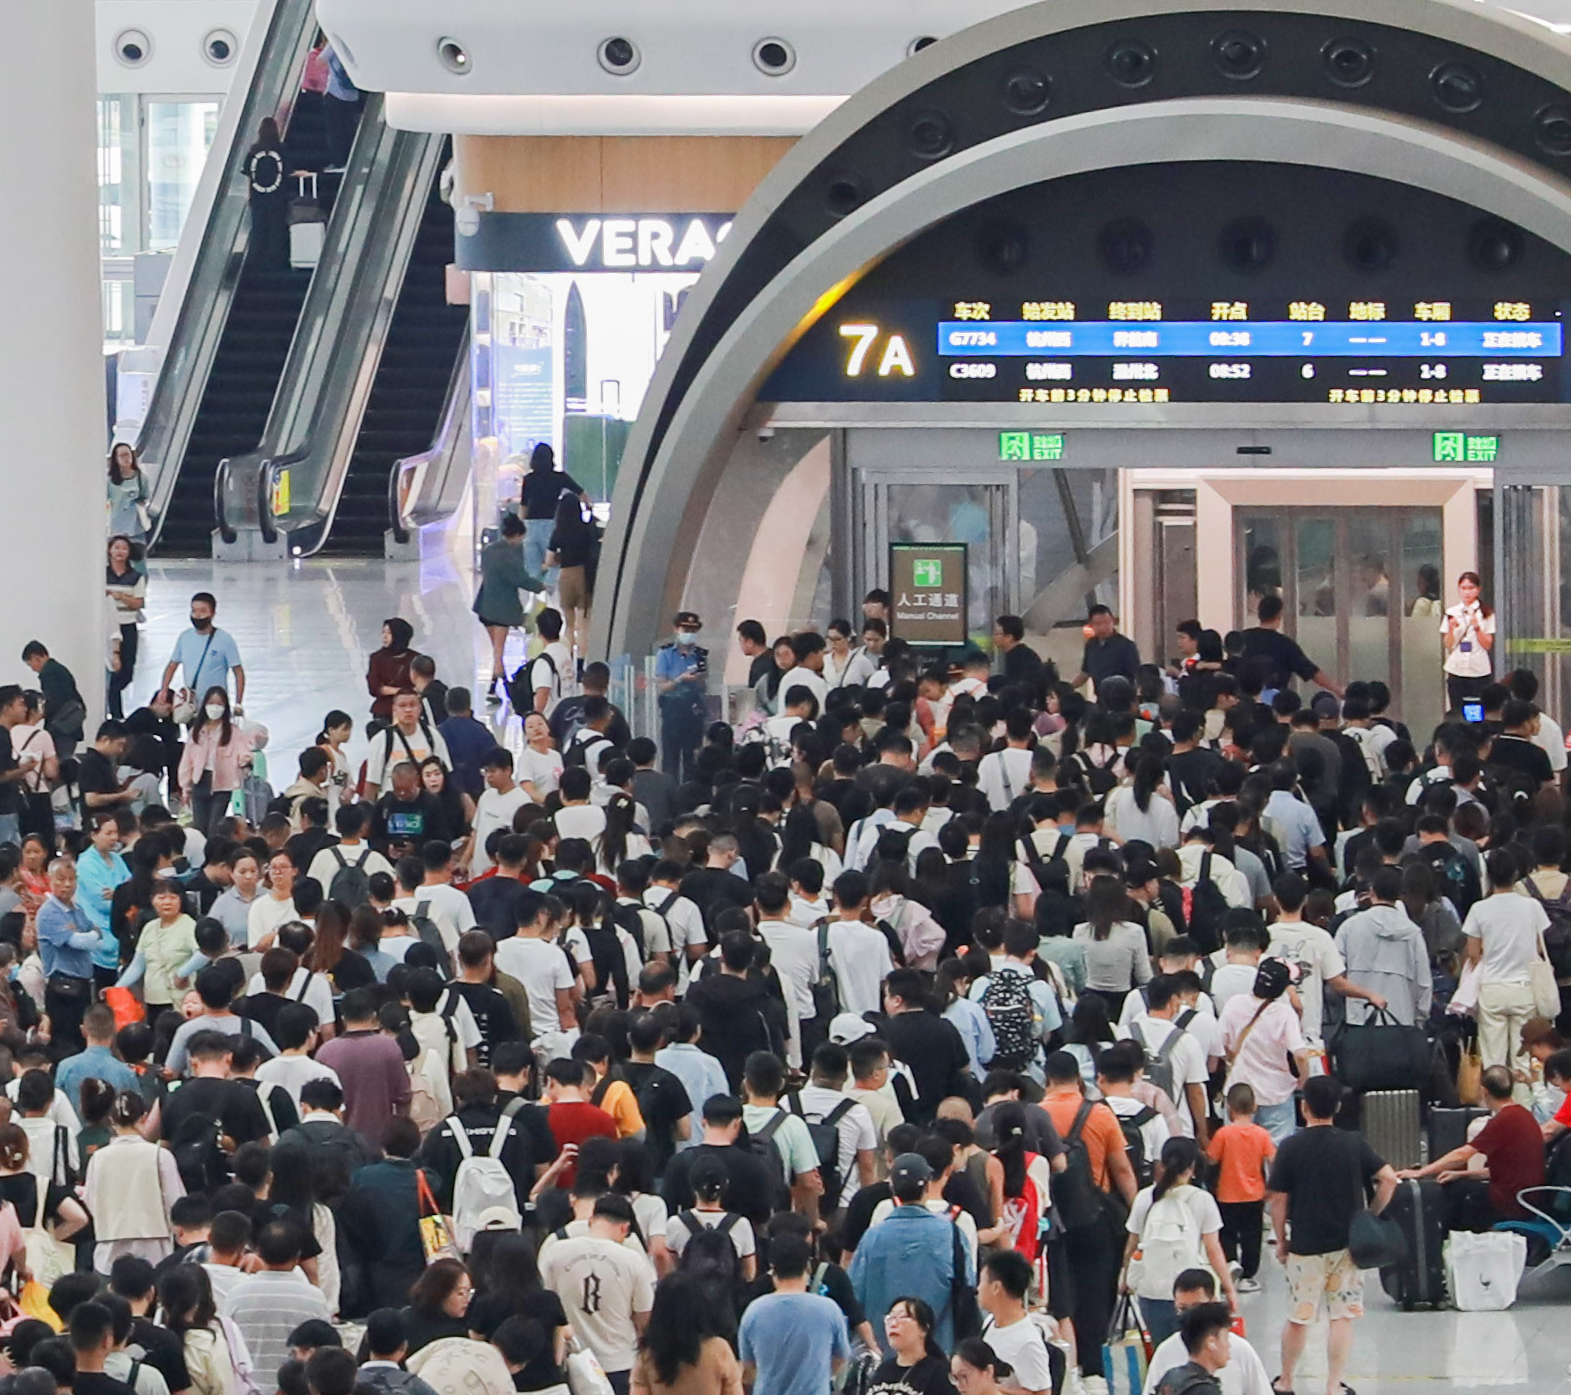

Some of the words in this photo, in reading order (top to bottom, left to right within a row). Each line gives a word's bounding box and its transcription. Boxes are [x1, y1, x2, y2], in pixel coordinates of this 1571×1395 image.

[556, 219, 732, 266] VERA
[955, 302, 990, 320] 车次
[1212, 302, 1247, 320] 开点
[1494, 302, 1530, 321] 状态
[841, 324, 913, 375] 7A
[1033, 449, 1062, 460] EXIT
[1468, 451, 1497, 461] EXIT
[897, 593, 959, 608] 人工通道
